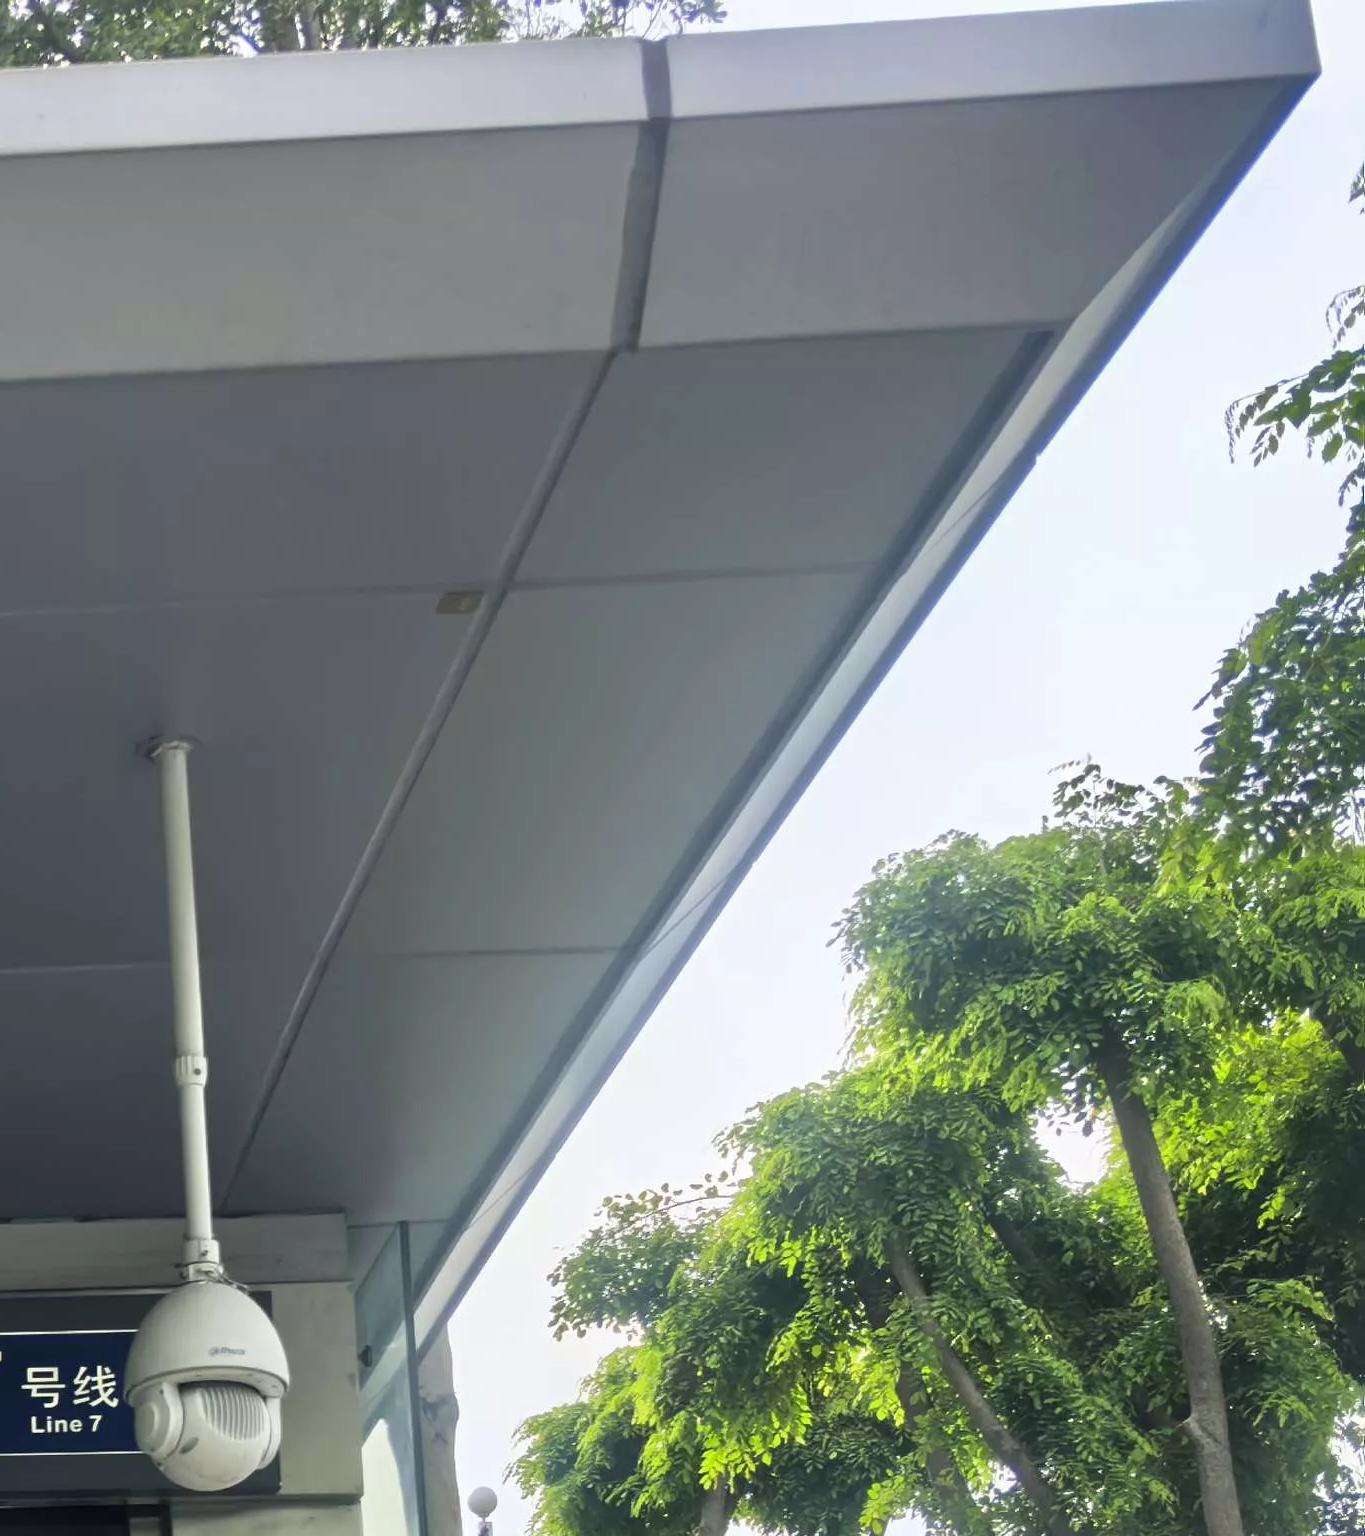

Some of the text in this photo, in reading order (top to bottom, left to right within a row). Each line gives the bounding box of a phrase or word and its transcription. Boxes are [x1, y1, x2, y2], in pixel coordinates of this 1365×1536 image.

[20, 1365, 119, 1409] 号线
[30, 1414, 102, 1434] Line 7
